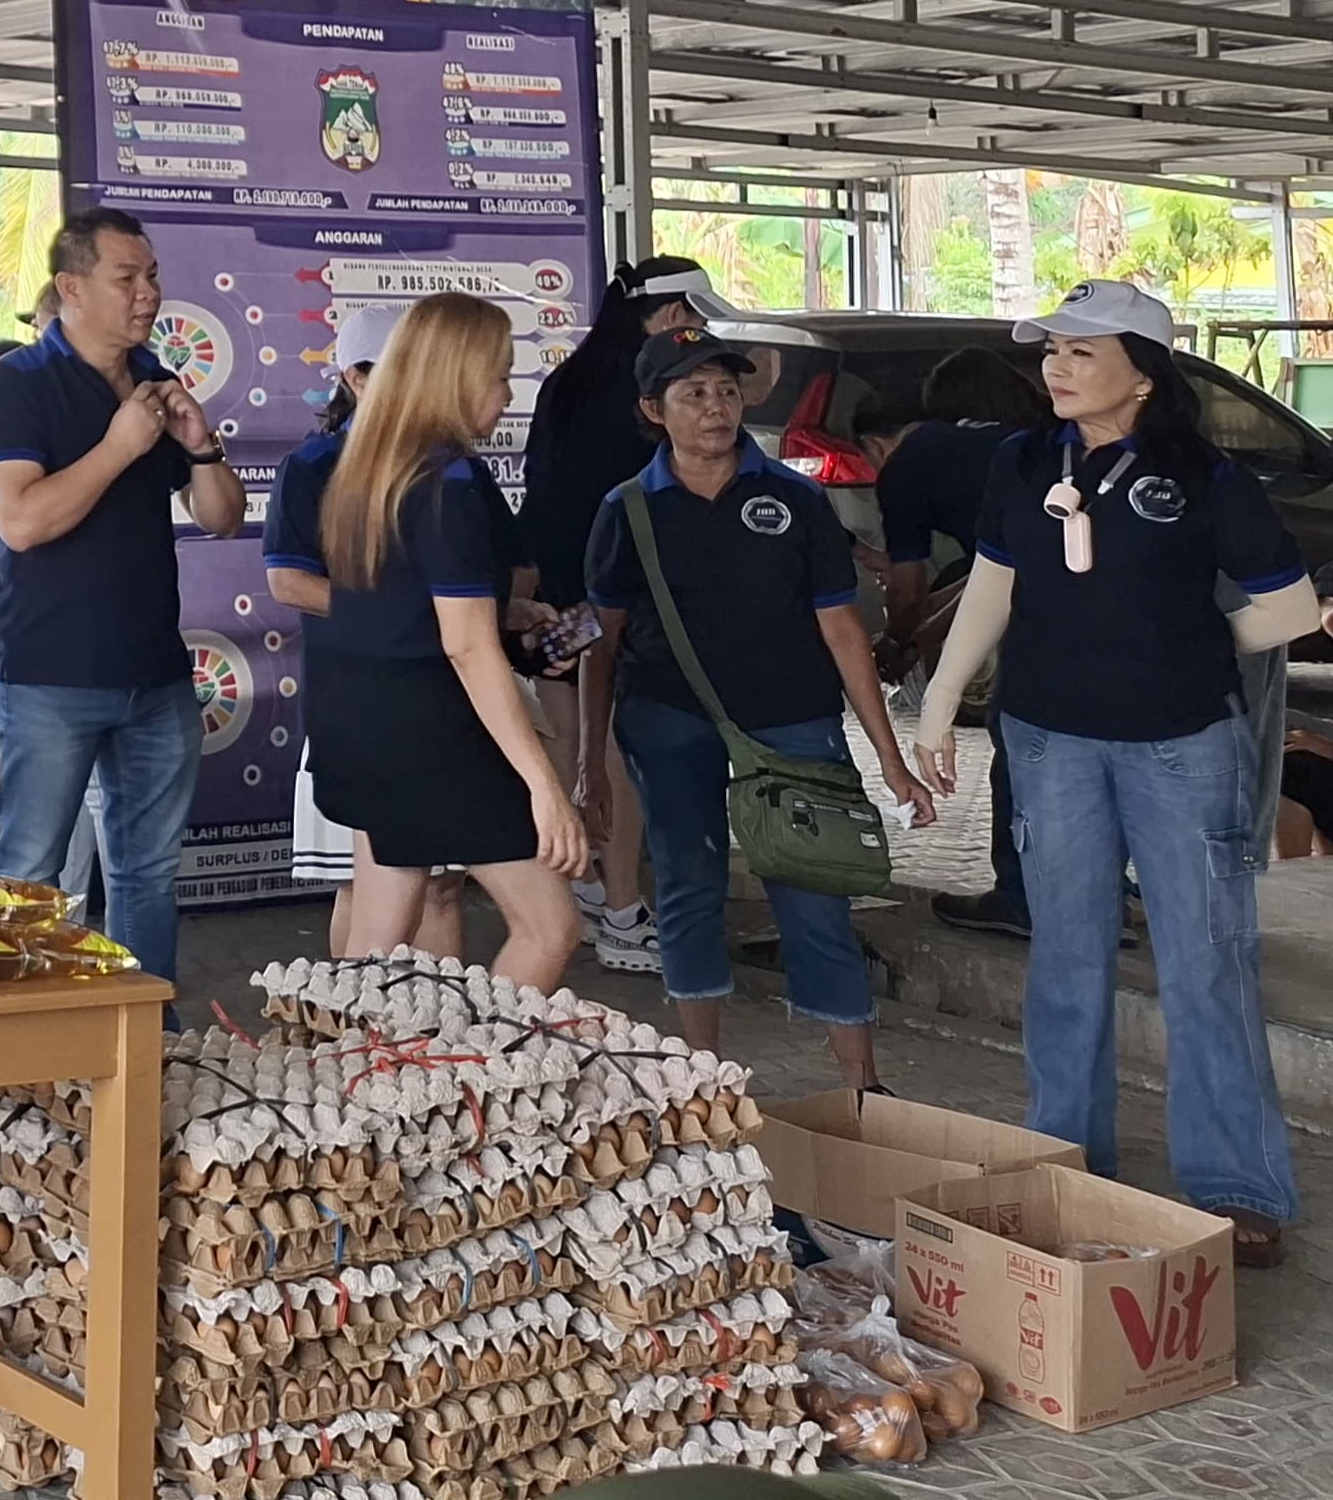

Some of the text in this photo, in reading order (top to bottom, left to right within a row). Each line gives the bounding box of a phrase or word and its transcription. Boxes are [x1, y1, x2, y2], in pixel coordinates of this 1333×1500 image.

[303, 23, 384, 43] PENDAPATAN
[141, 188, 212, 201] PENDAPATAN
[315, 229, 382, 246] ANGGARAN
[378, 274, 397, 291] RP.
[237, 467, 276, 480] ARAN
[222, 820, 292, 839] REALISASI
[196, 851, 260, 868] SURPLUS
[904, 1240, 918, 1255] 24
[928, 1250, 949, 1267] 550
[950, 1259, 965, 1273] ml
[907, 1265, 967, 1318] Vit
[1110, 1254, 1221, 1372] Vit
